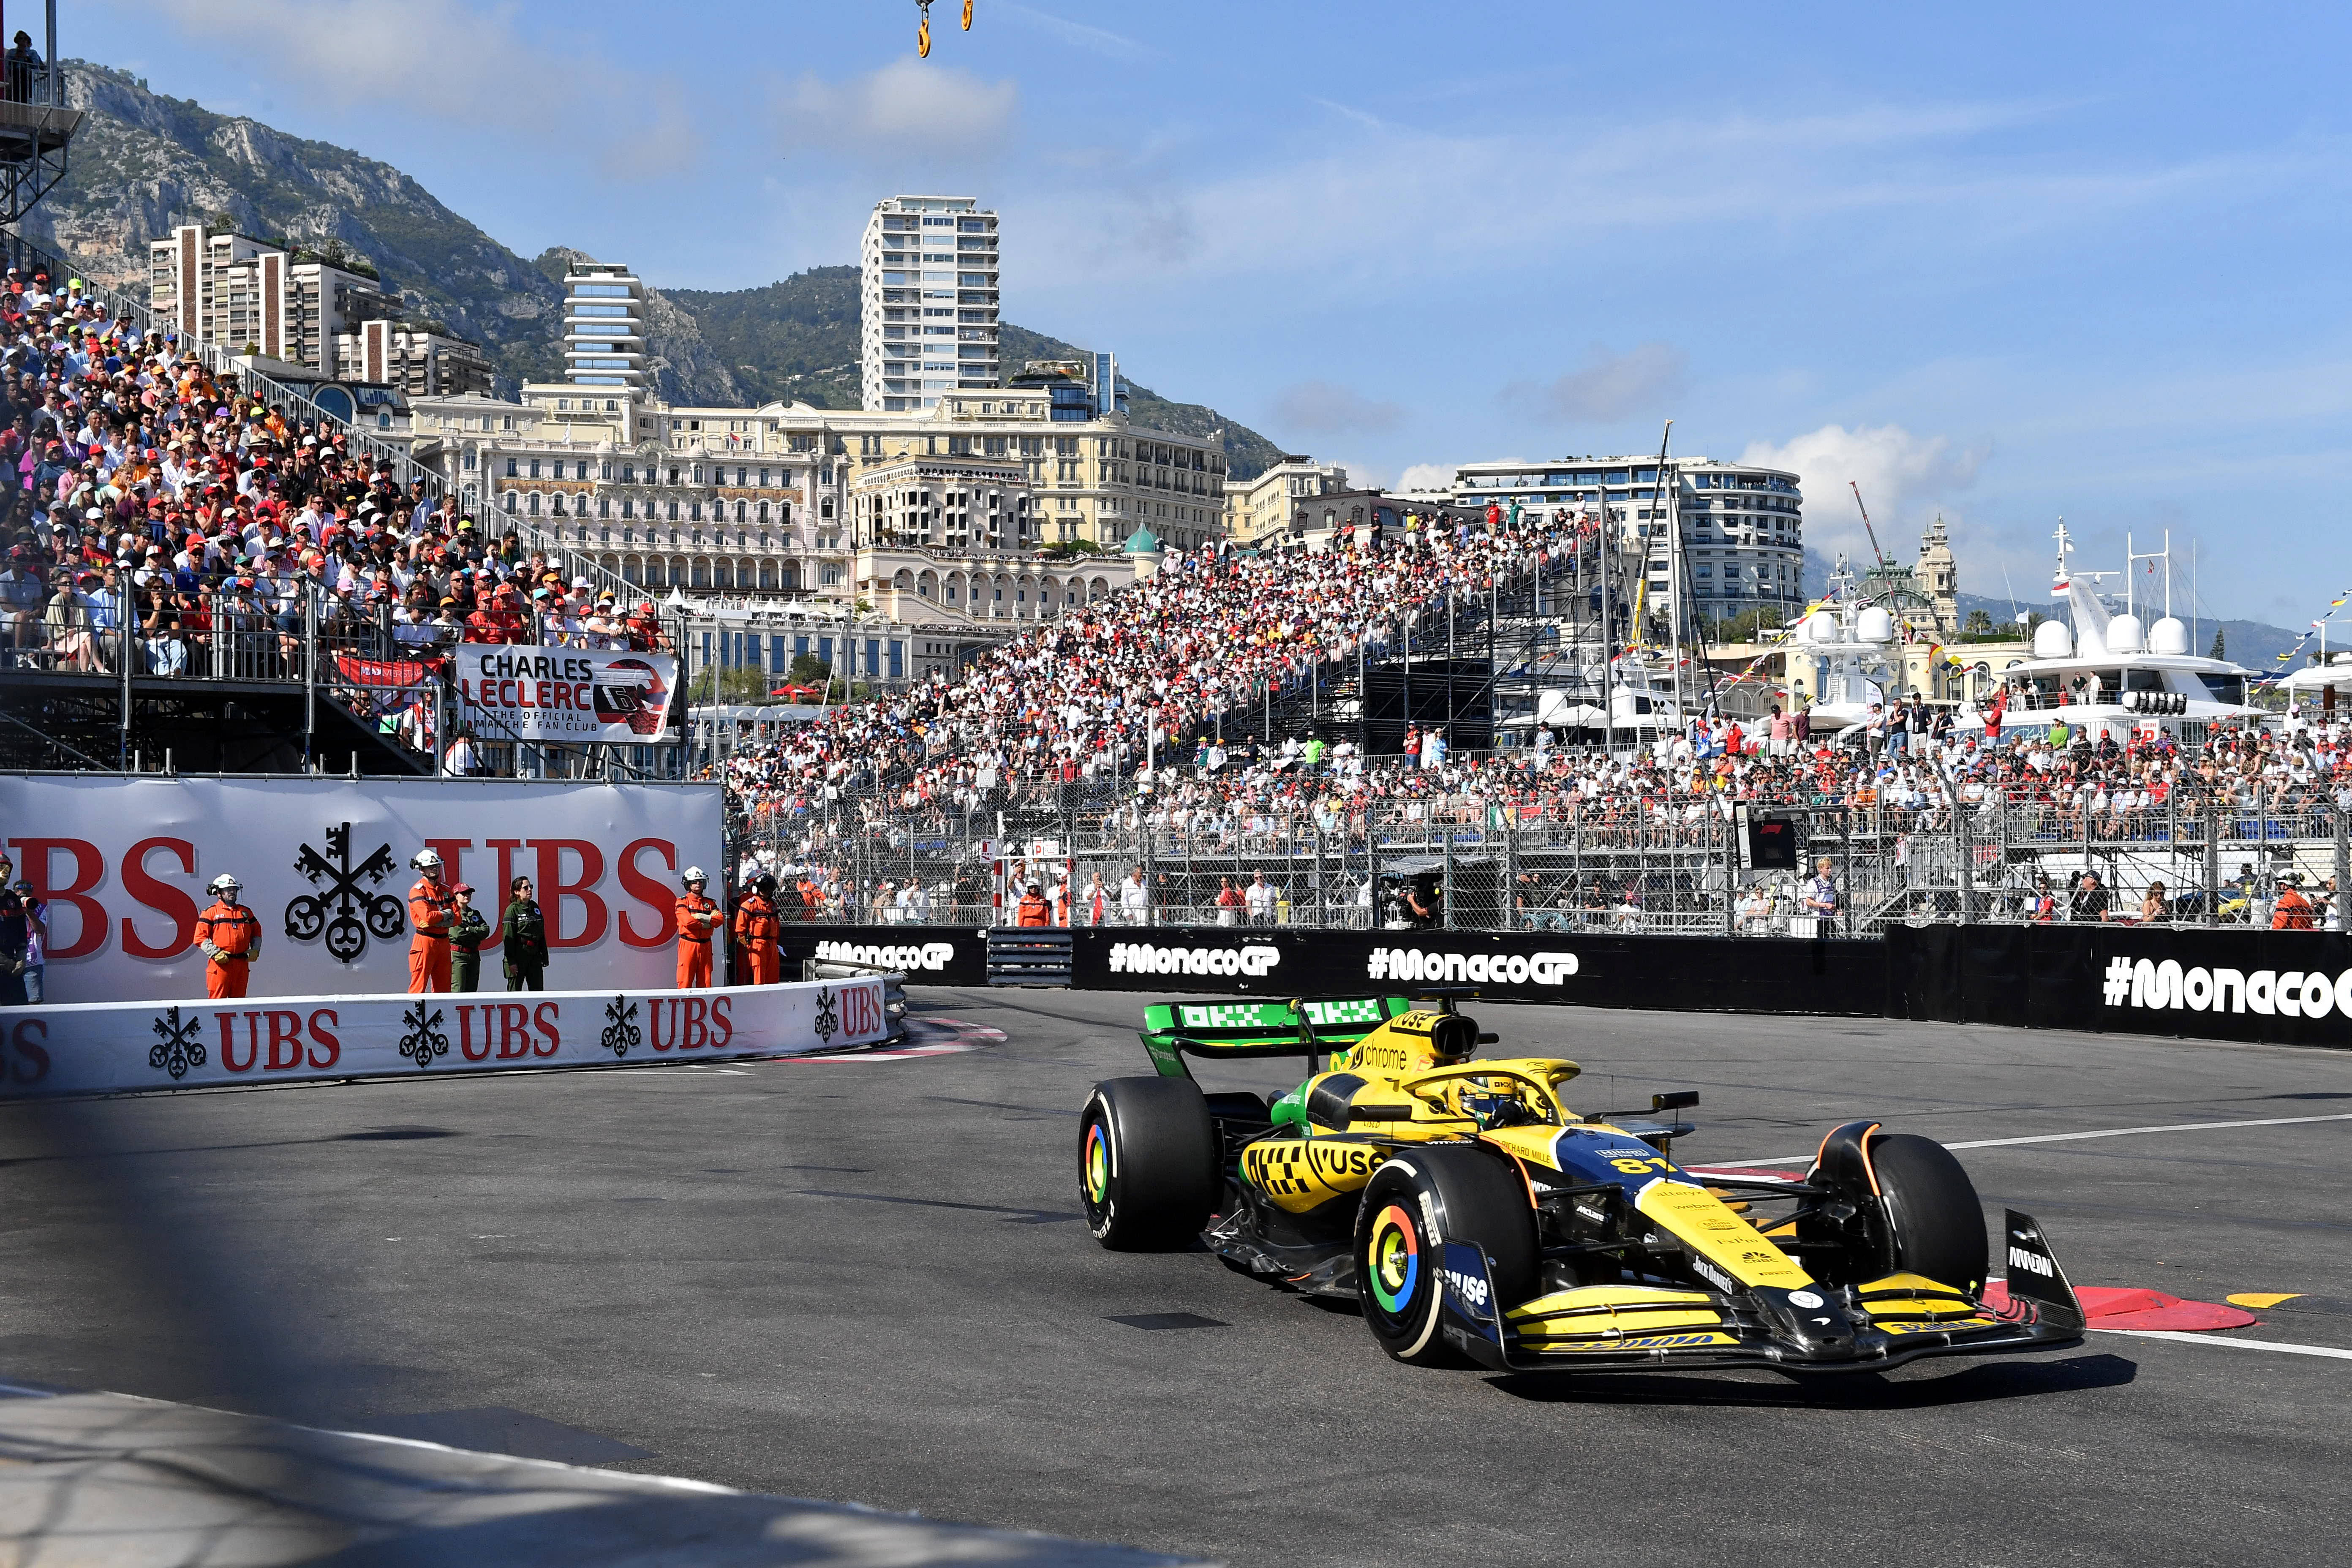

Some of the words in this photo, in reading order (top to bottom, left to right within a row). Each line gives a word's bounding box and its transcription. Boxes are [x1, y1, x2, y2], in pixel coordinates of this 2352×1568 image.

[1535, 616, 1564, 626] Heuer
[361, 667, 381, 675] MAX
[480, 654, 593, 681] CHARLES
[462, 678, 591, 711] LECLERC
[476, 719, 529, 729] MARCHE
[538, 721, 559, 730] FAN
[566, 722, 597, 732] CLUB
[492, 710, 515, 719] THE
[523, 711, 582, 722] OFFICIAL
[425, 838, 678, 948] UBS
[815, 940, 954, 970] #MonacoGP
[1109, 942, 1280, 977] #MonacoGP
[1367, 947, 1579, 985] #MonacoGP
[648, 996, 732, 1051] UBS
[841, 985, 881, 1037] UBS
[1183, 1004, 1263, 1027] OKX
[214, 1009, 340, 1072] UBS
[455, 1002, 561, 1061] UBS
[1365, 1038, 1407, 1070] chrome
[1501, 1141, 1530, 1157] RICHARD
[1532, 1150, 1551, 1164] MILLE
[1610, 1157, 1679, 1174] 81
[1248, 1146, 1311, 1195] OKX
[2009, 1246, 2053, 1278] ARROW
